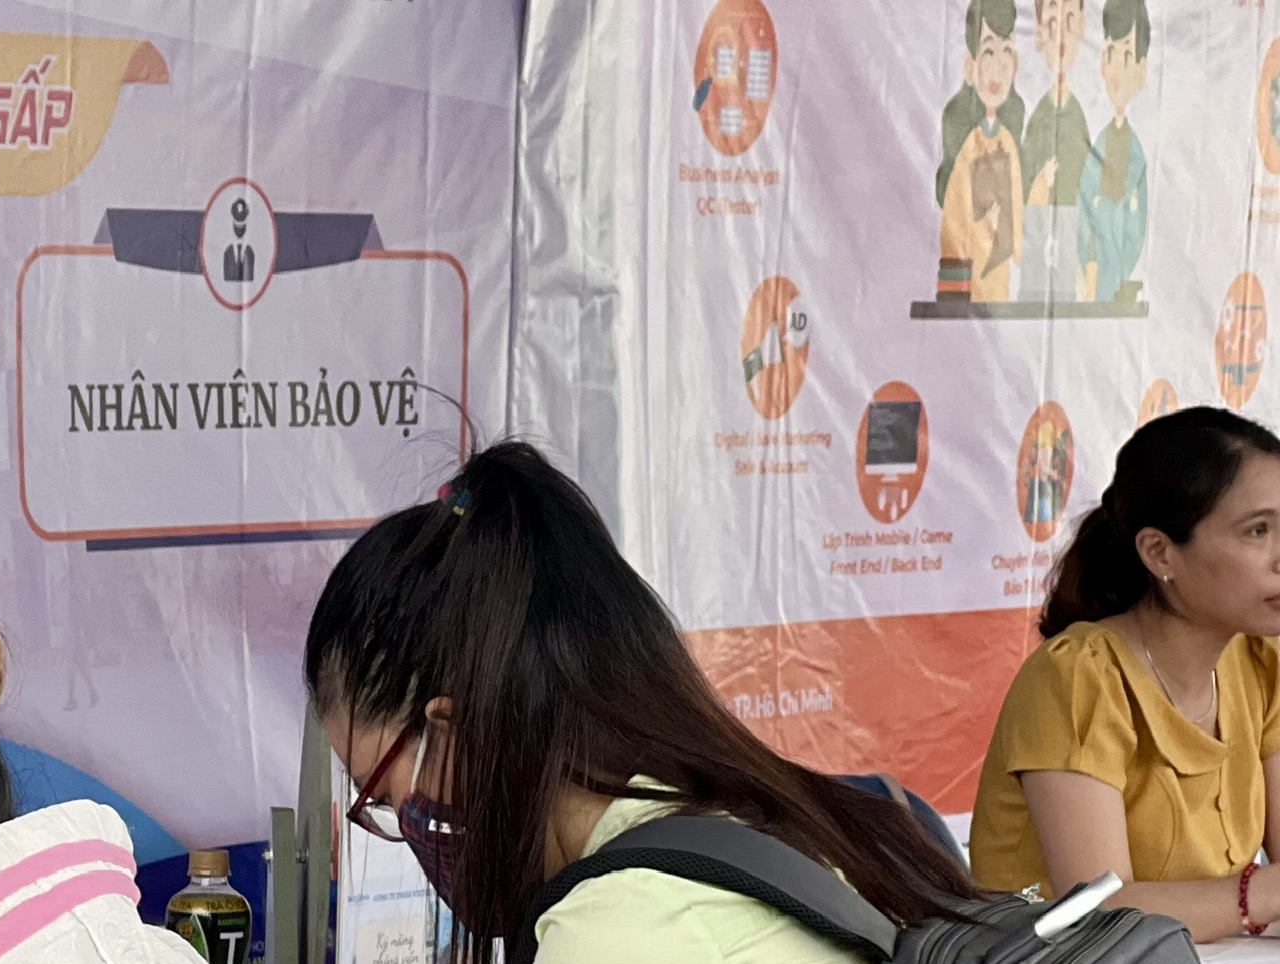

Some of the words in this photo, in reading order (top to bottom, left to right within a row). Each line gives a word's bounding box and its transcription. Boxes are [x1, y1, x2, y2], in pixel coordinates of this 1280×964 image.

[790, 312, 808, 331] AD
[68, 369, 179, 432] NHÂN
[187, 368, 278, 430] VIÊN
[288, 367, 362, 428] BẢO
[369, 366, 420, 438] VỆ
